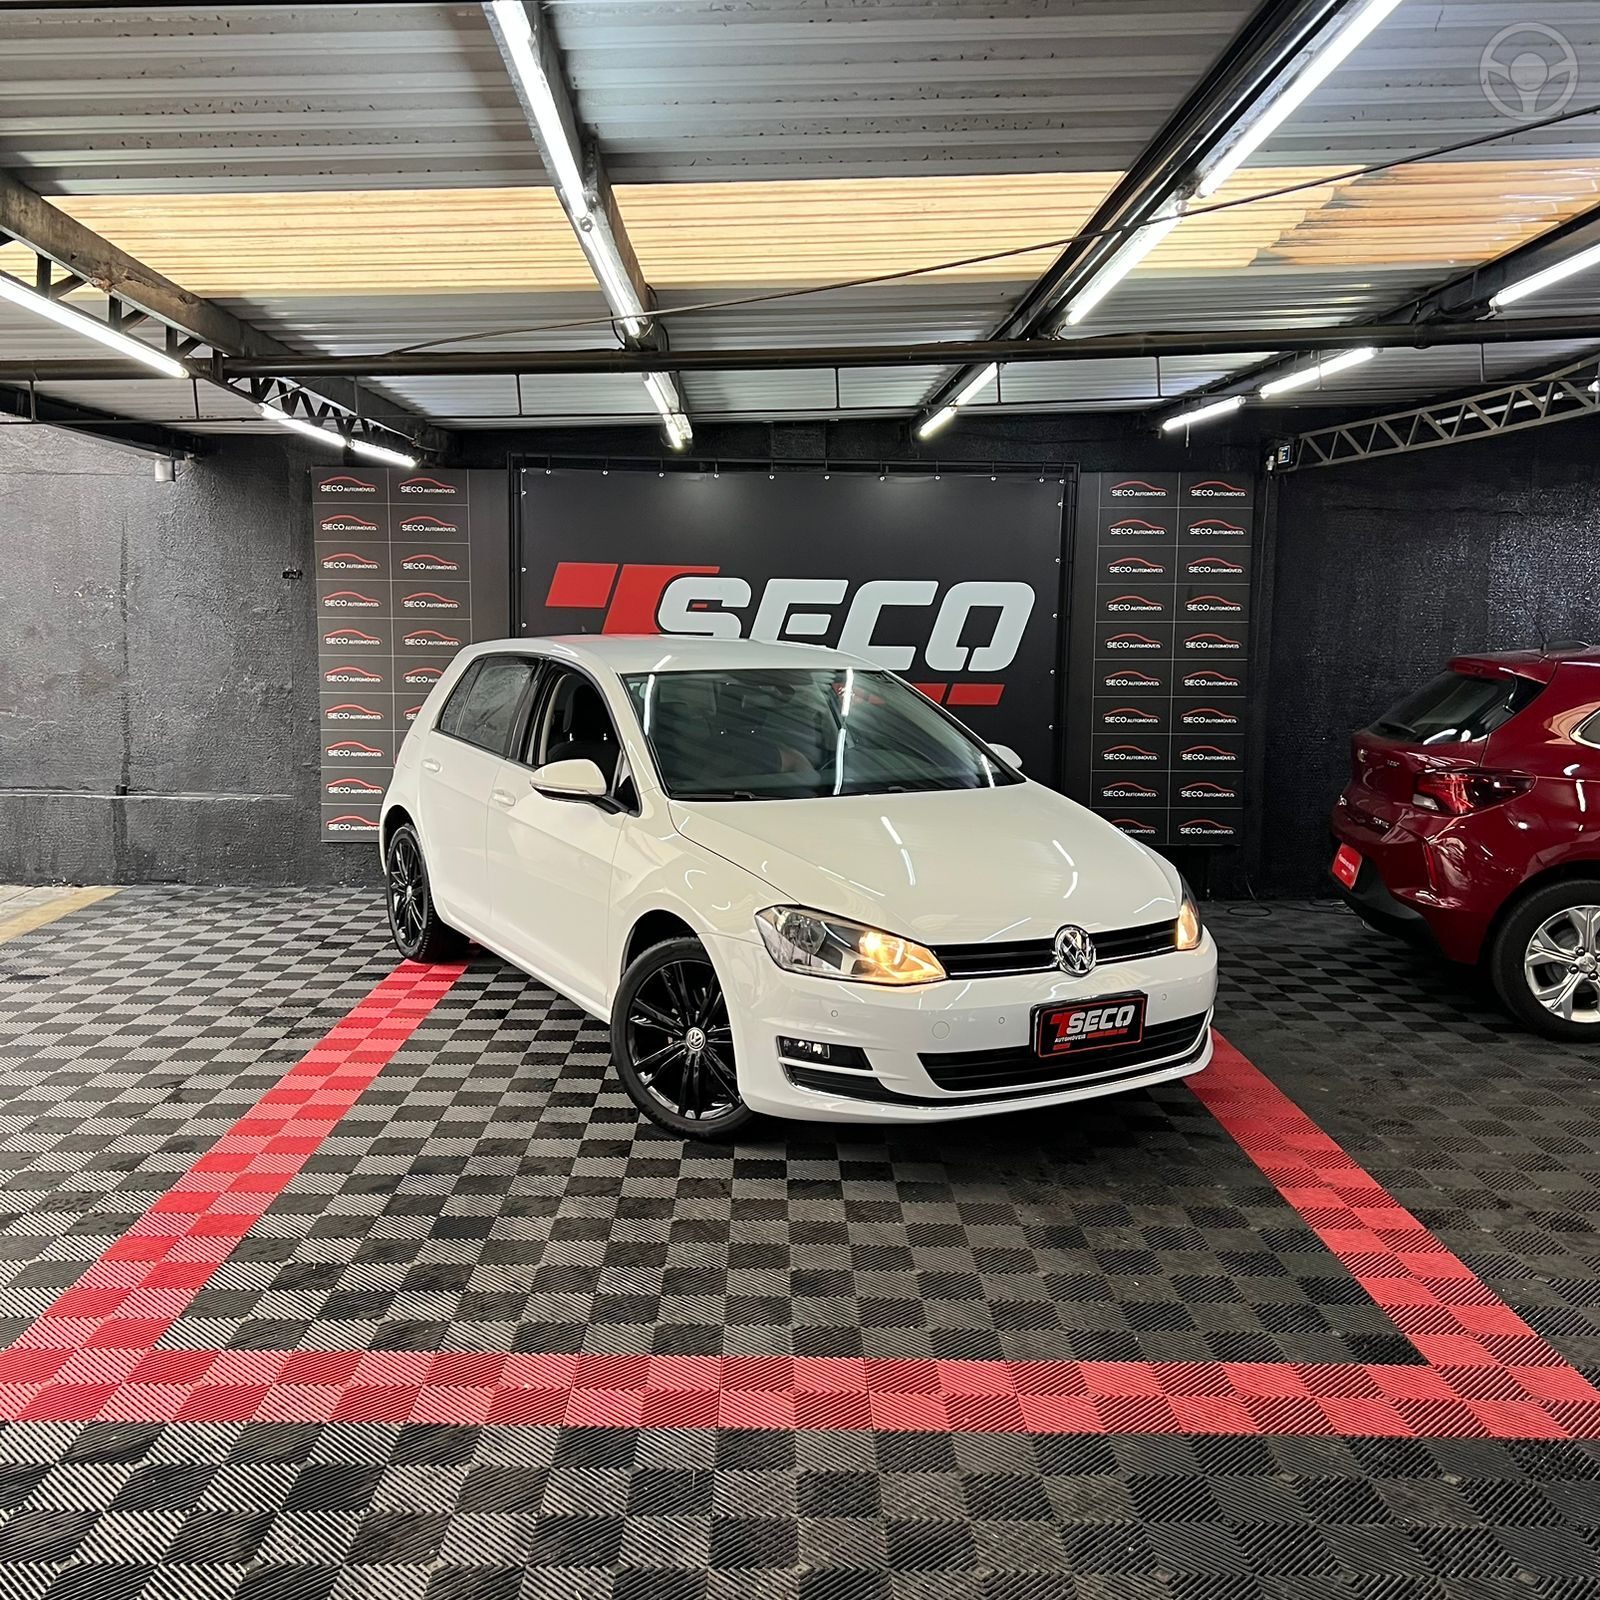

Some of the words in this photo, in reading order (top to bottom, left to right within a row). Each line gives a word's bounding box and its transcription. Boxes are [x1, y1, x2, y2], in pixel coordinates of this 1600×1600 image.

[1112, 489, 1134, 497] SECO
[1191, 489, 1214, 497] SECO
[322, 523, 344, 531] SECO
[404, 600, 426, 608] SECO
[657, 576, 1035, 672] SECO
[325, 637, 348, 645] SECO
[404, 638, 427, 646] SECO
[327, 712, 350, 720] SECO
[1183, 716, 1205, 724] SECO
[1104, 753, 1126, 761] SECO
[1182, 753, 1204, 761] SECO
[328, 823, 351, 831] SECO
[1066, 1005, 1135, 1035] SECO
